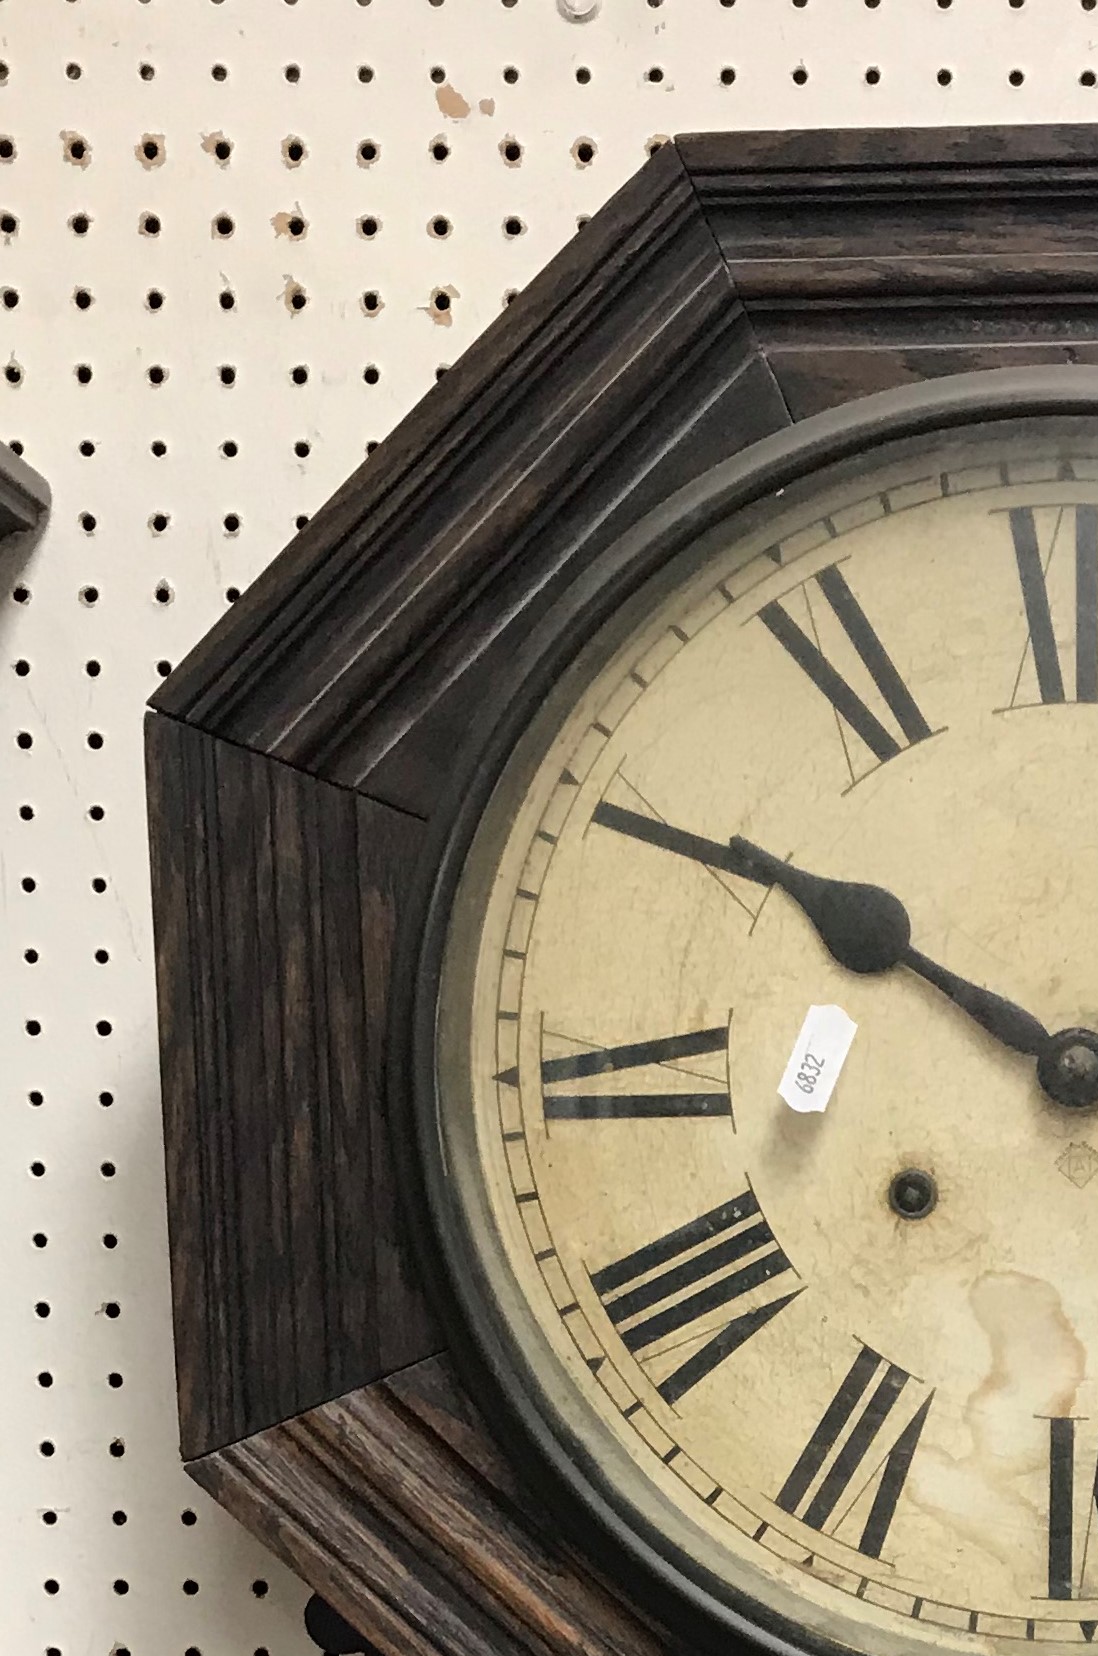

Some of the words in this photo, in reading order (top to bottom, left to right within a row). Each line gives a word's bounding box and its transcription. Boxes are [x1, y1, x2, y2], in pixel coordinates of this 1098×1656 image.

[741, 556, 949, 797] XI
[581, 755, 794, 936] X
[539, 1008, 735, 1138] IX
[795, 1053, 826, 1095] 6832
[583, 1170, 808, 1419] VIII
[769, 1334, 936, 1569] VII
